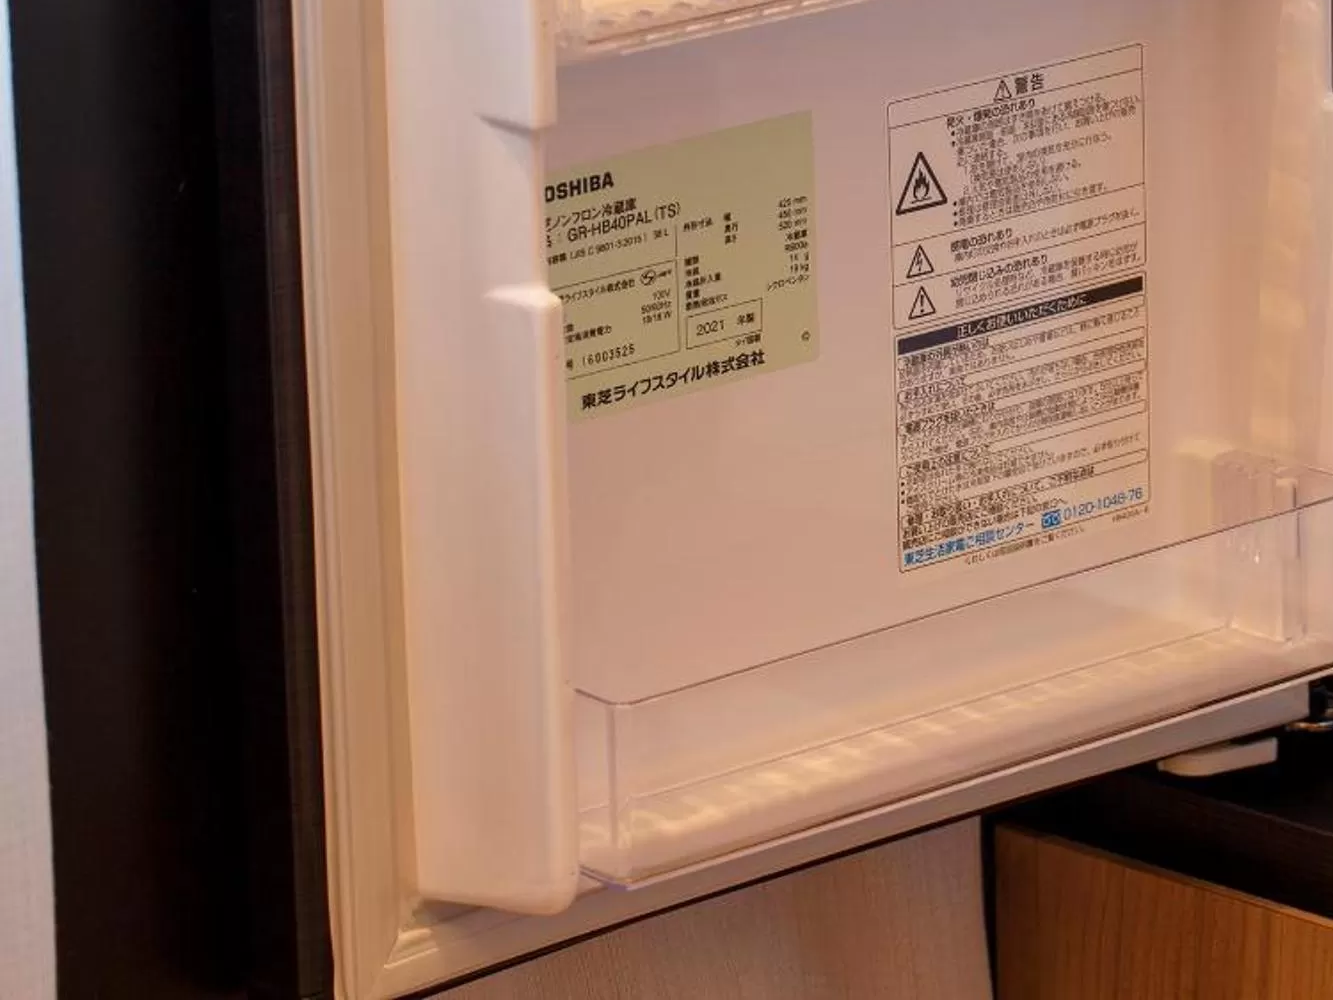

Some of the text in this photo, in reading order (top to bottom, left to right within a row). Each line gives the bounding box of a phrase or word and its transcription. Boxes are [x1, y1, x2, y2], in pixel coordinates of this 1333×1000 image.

[545, 171, 614, 203] OSHIBA
[696, 320, 725, 336] 2021
[582, 349, 766, 410] 東芝ライフスタイル株式会社
